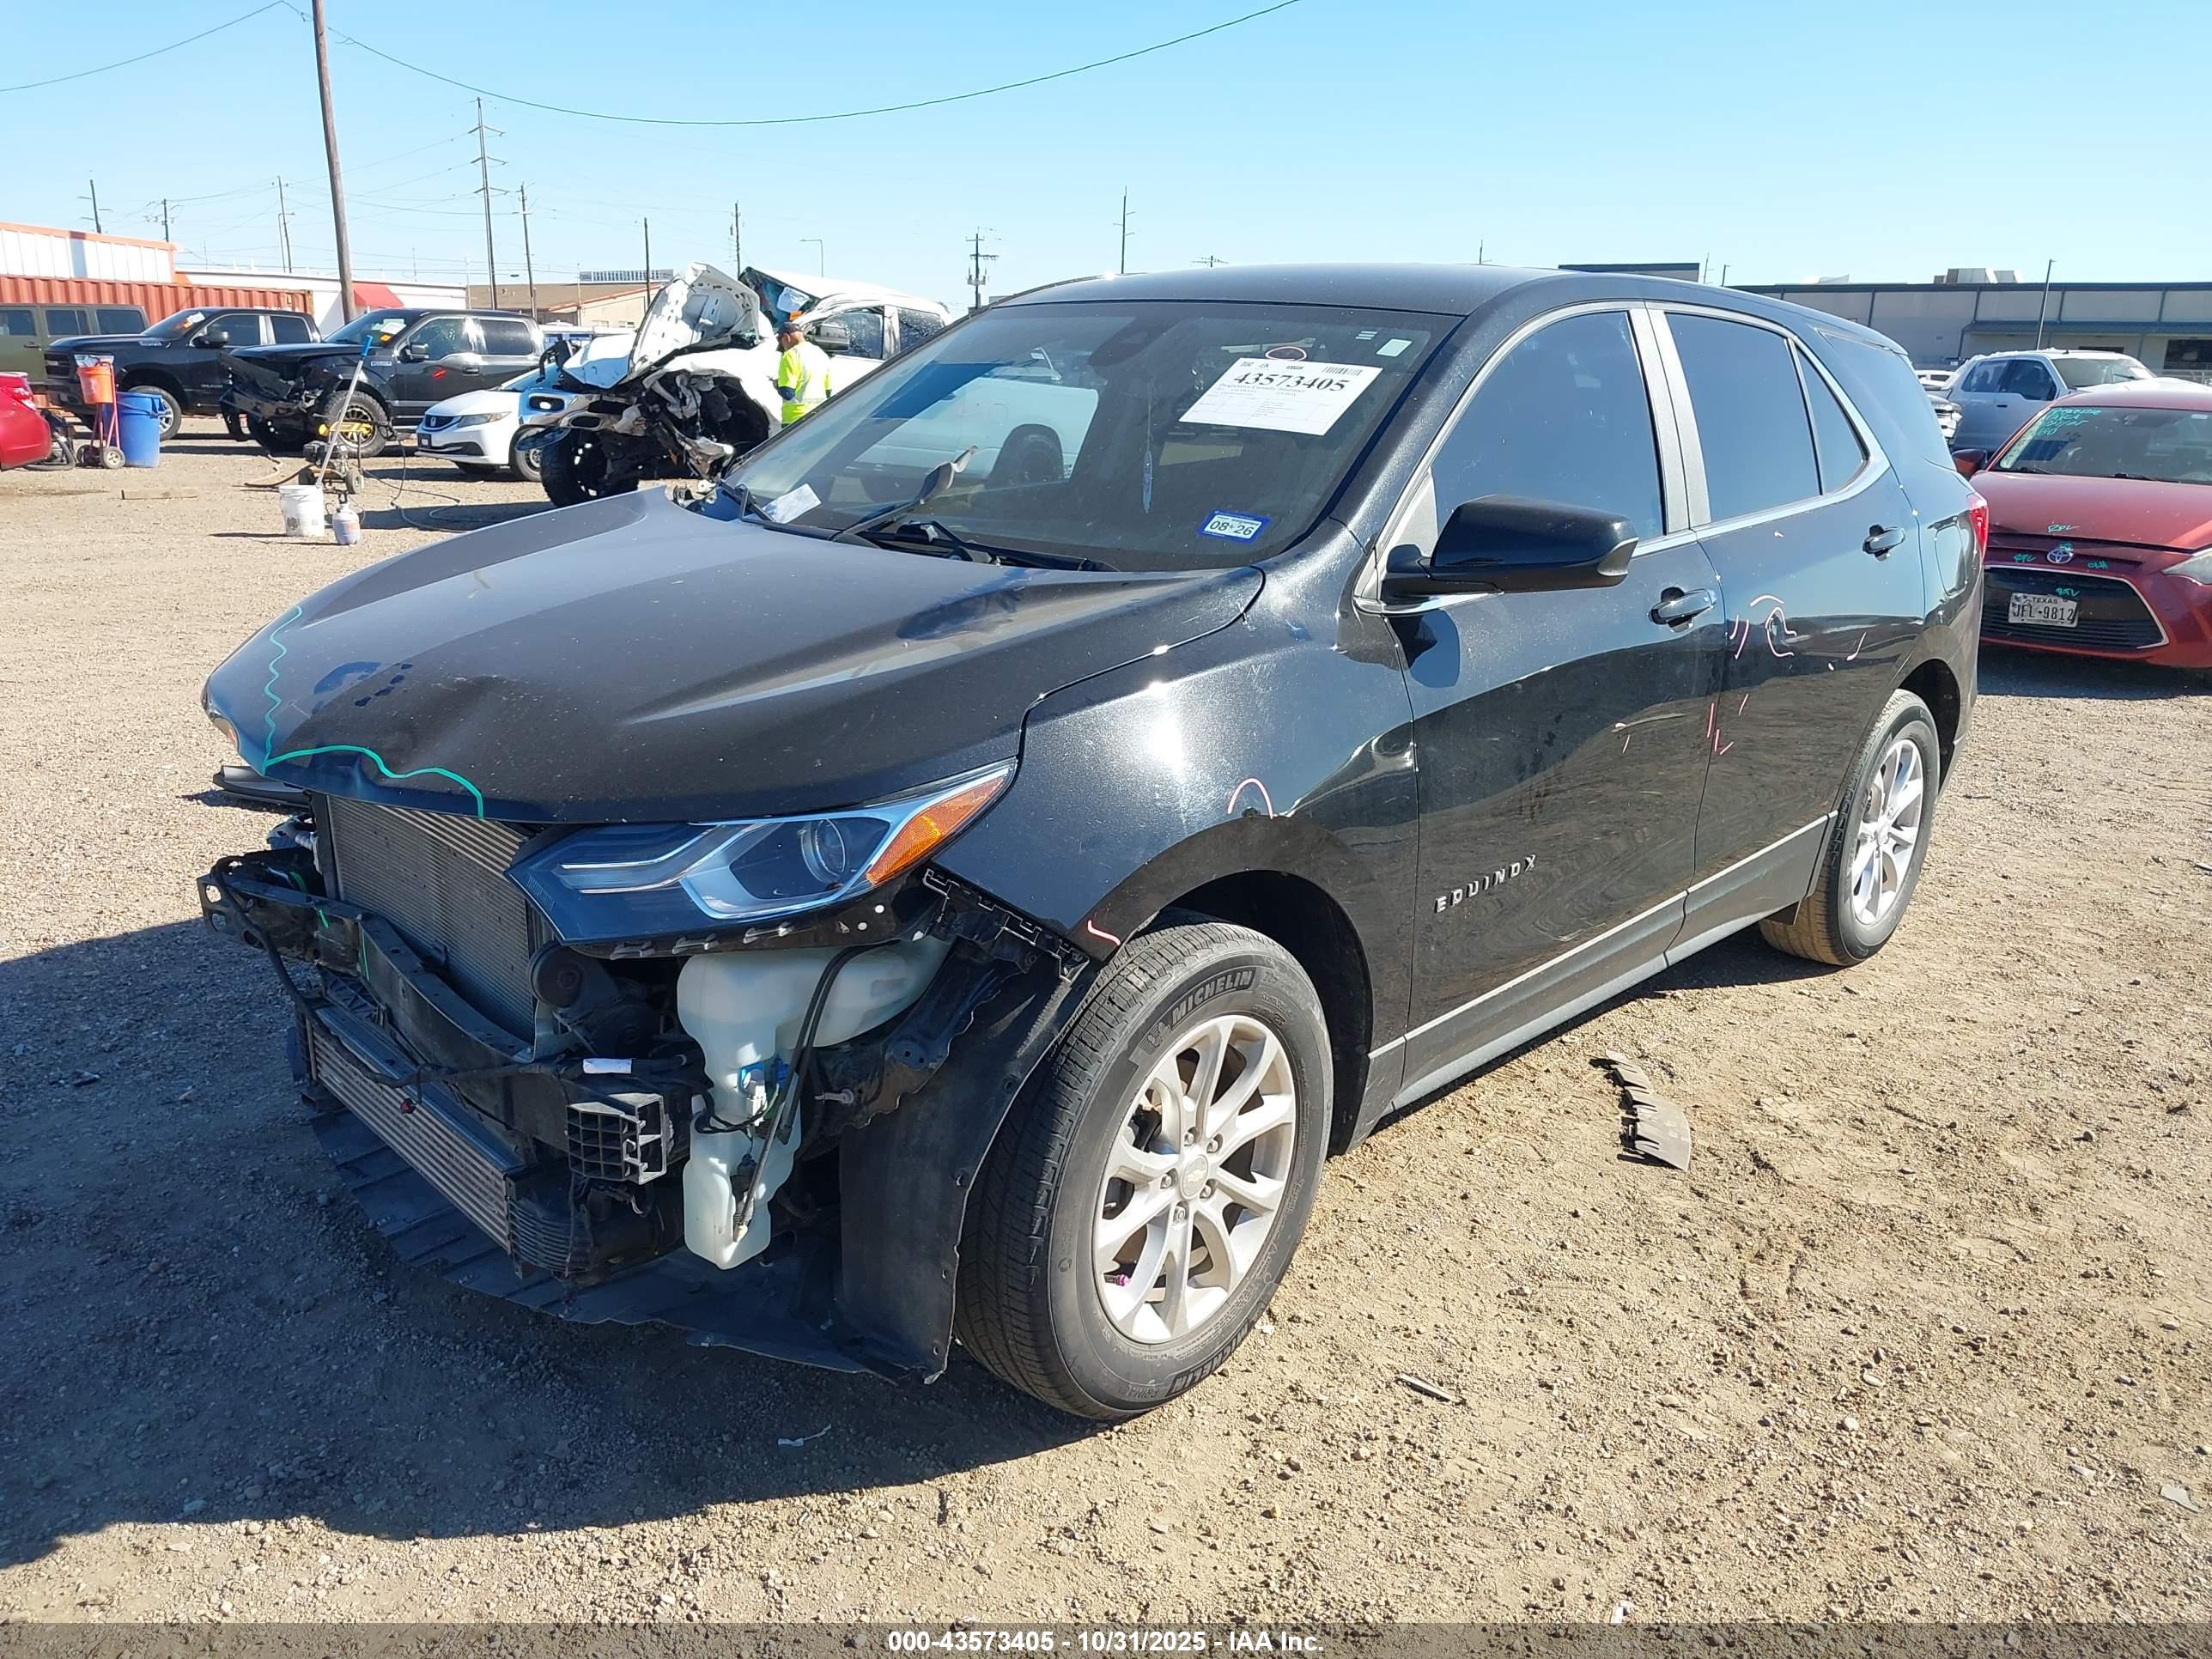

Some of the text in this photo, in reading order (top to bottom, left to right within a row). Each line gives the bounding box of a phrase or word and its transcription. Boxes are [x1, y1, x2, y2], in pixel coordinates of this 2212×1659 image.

[1234, 372, 1350, 392] 43573405
[1209, 520, 1230, 532] 08
[1233, 525, 1255, 536] 26
[1434, 854, 1535, 913] EQUINOX
[1171, 970, 1253, 1024] MICHELIN
